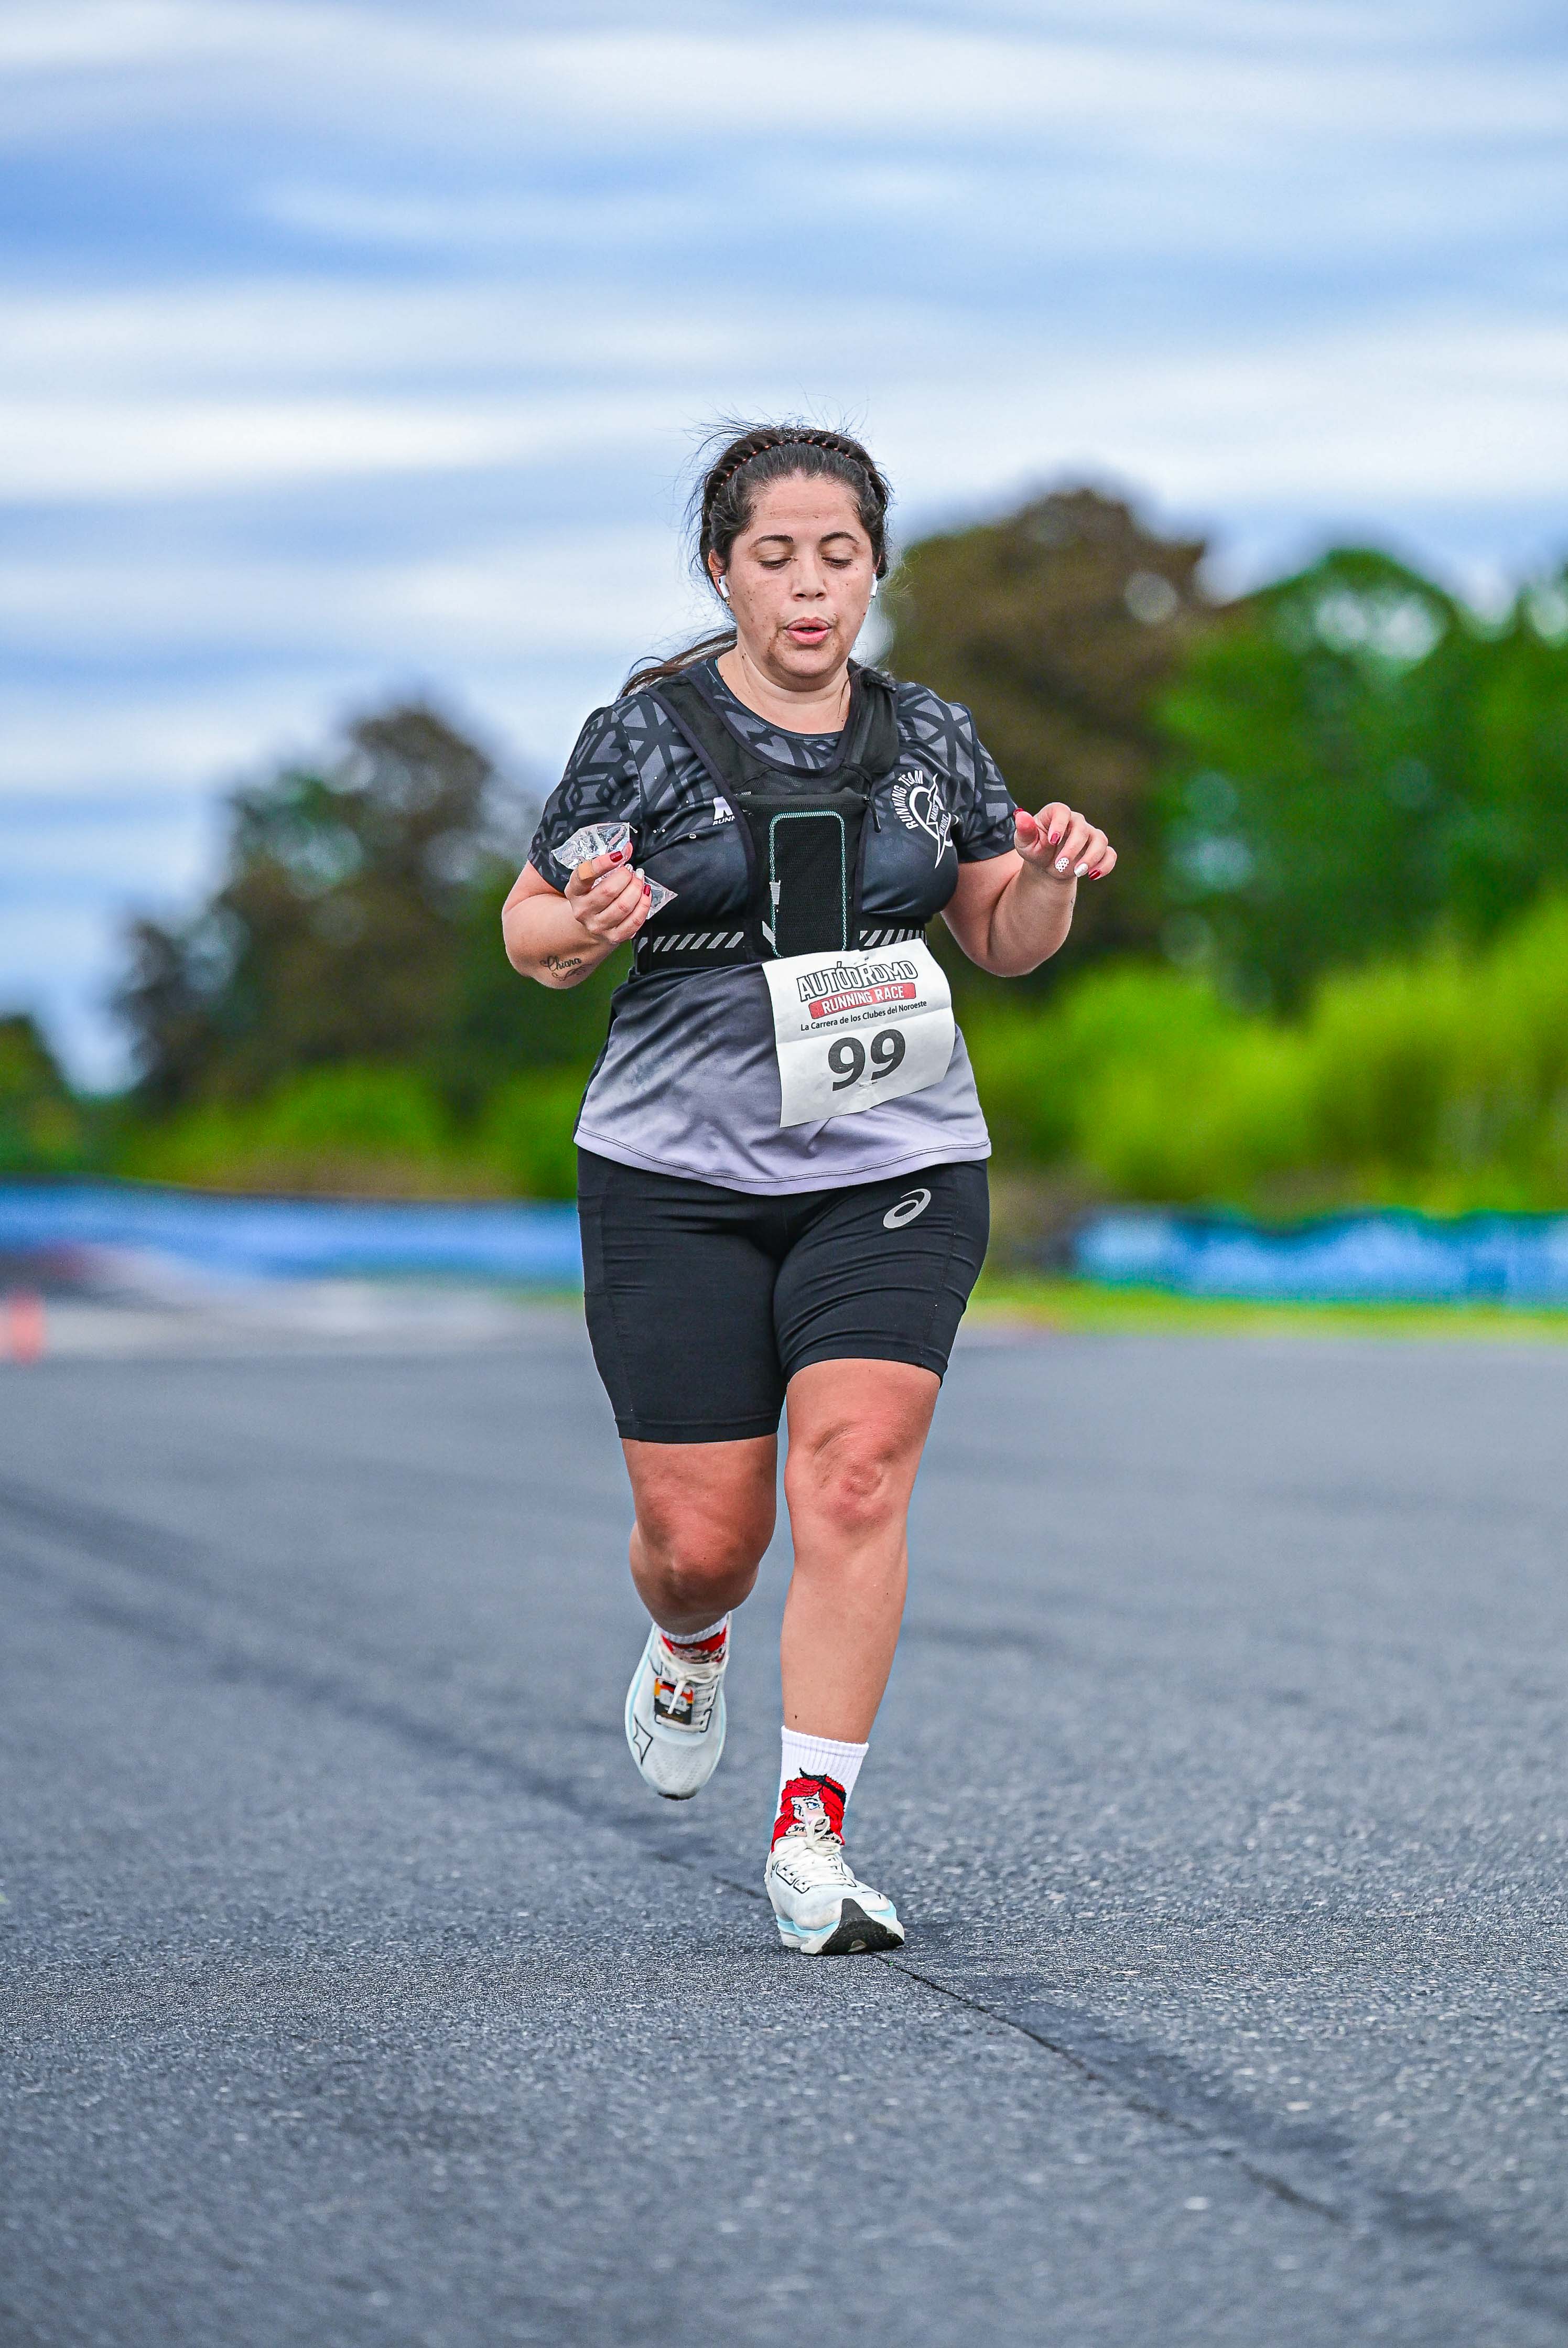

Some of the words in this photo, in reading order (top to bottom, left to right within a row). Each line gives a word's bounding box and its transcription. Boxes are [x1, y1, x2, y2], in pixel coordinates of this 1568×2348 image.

[897, 770, 924, 787] TEAM
[891, 784, 919, 830] RUNNING
[939, 813, 949, 837] MENDEZ
[796, 961, 918, 1002] AUTÓDROMO
[821, 990, 873, 1014] RUNNING
[874, 985, 905, 1001] RACE
[810, 1019, 838, 1030] Carrera
[839, 1016, 849, 1025] de
[850, 1014, 861, 1022] los
[862, 1010, 886, 1020] Clubes
[887, 1005, 898, 1015] del
[899, 1000, 928, 1013] Noroeste
[828, 1029, 906, 1092] 99
